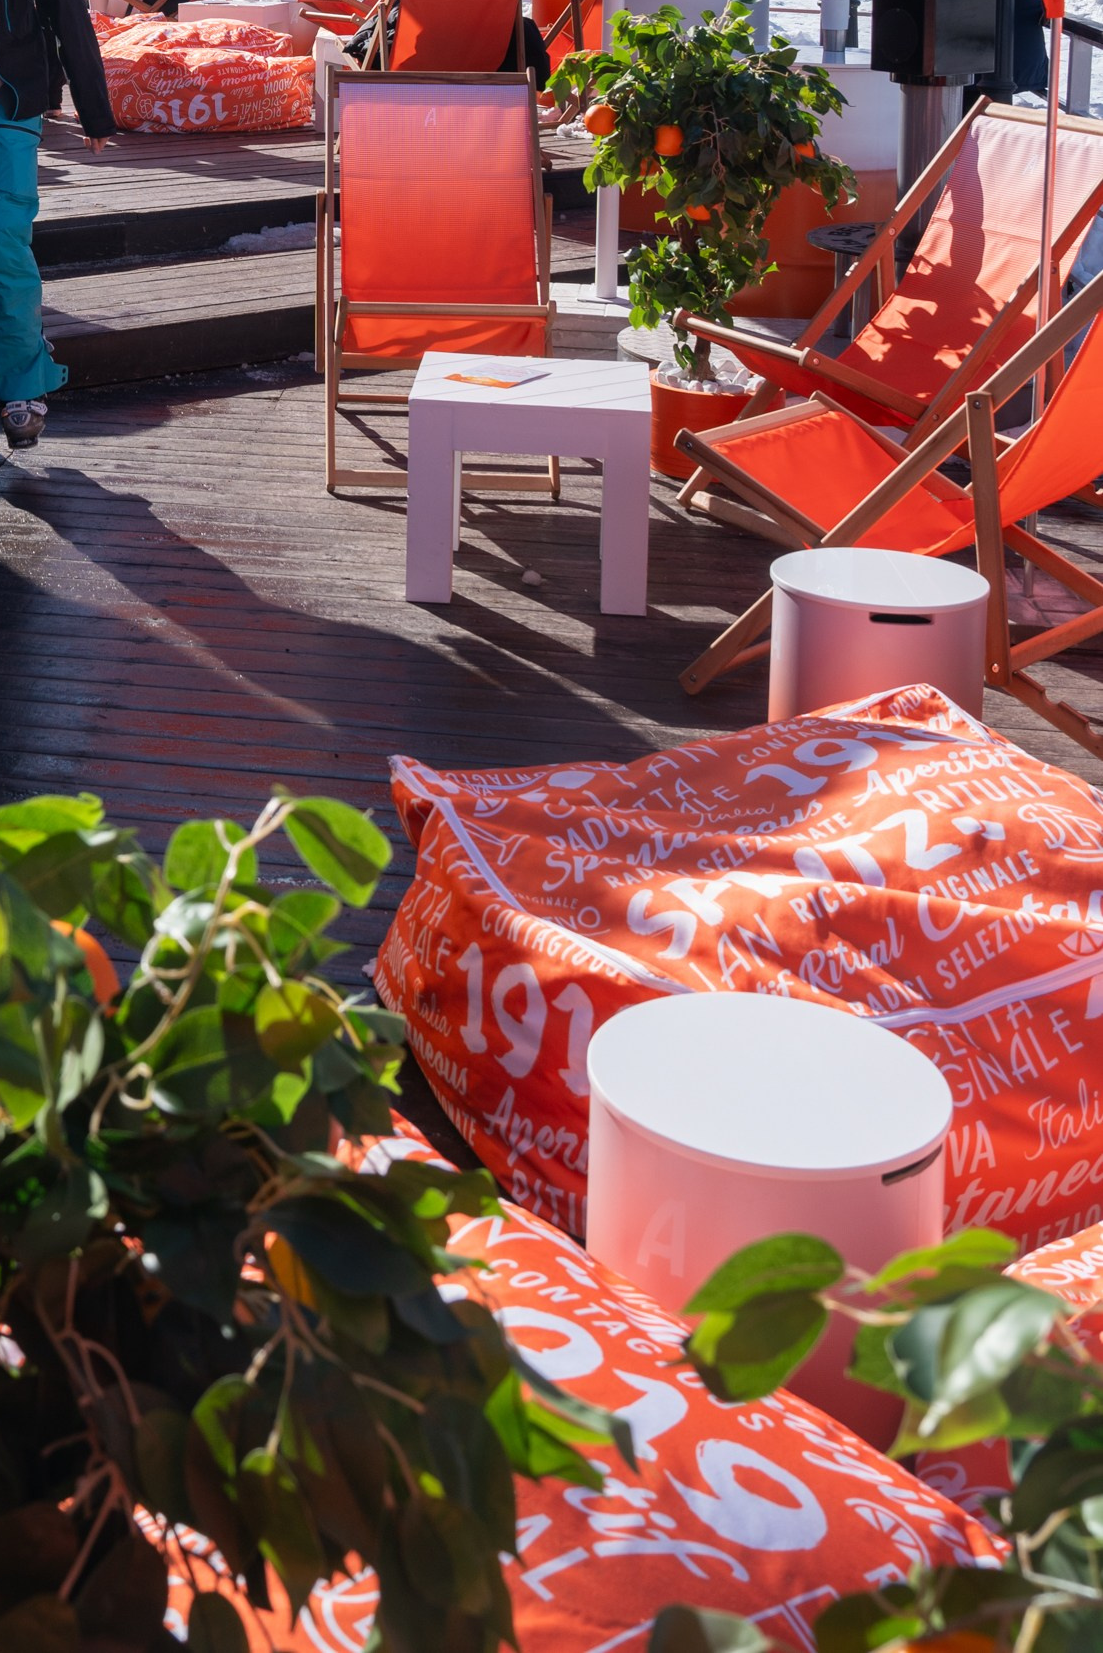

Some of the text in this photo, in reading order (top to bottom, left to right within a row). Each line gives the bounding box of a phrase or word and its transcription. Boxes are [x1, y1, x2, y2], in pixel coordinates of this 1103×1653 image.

[220, 63, 299, 87] Spontaneous
[263, 78, 294, 95] PADOVA
[231, 93, 289, 116] ORIGINALE
[237, 105, 282, 127] RICETTA
[852, 747, 1021, 808] Aperitif
[913, 772, 1056, 814] RITUAL
[481, 903, 620, 978] CONTAGIOUS
[797, 917, 904, 994] Ritual
[637, 1198, 686, 1278] A
